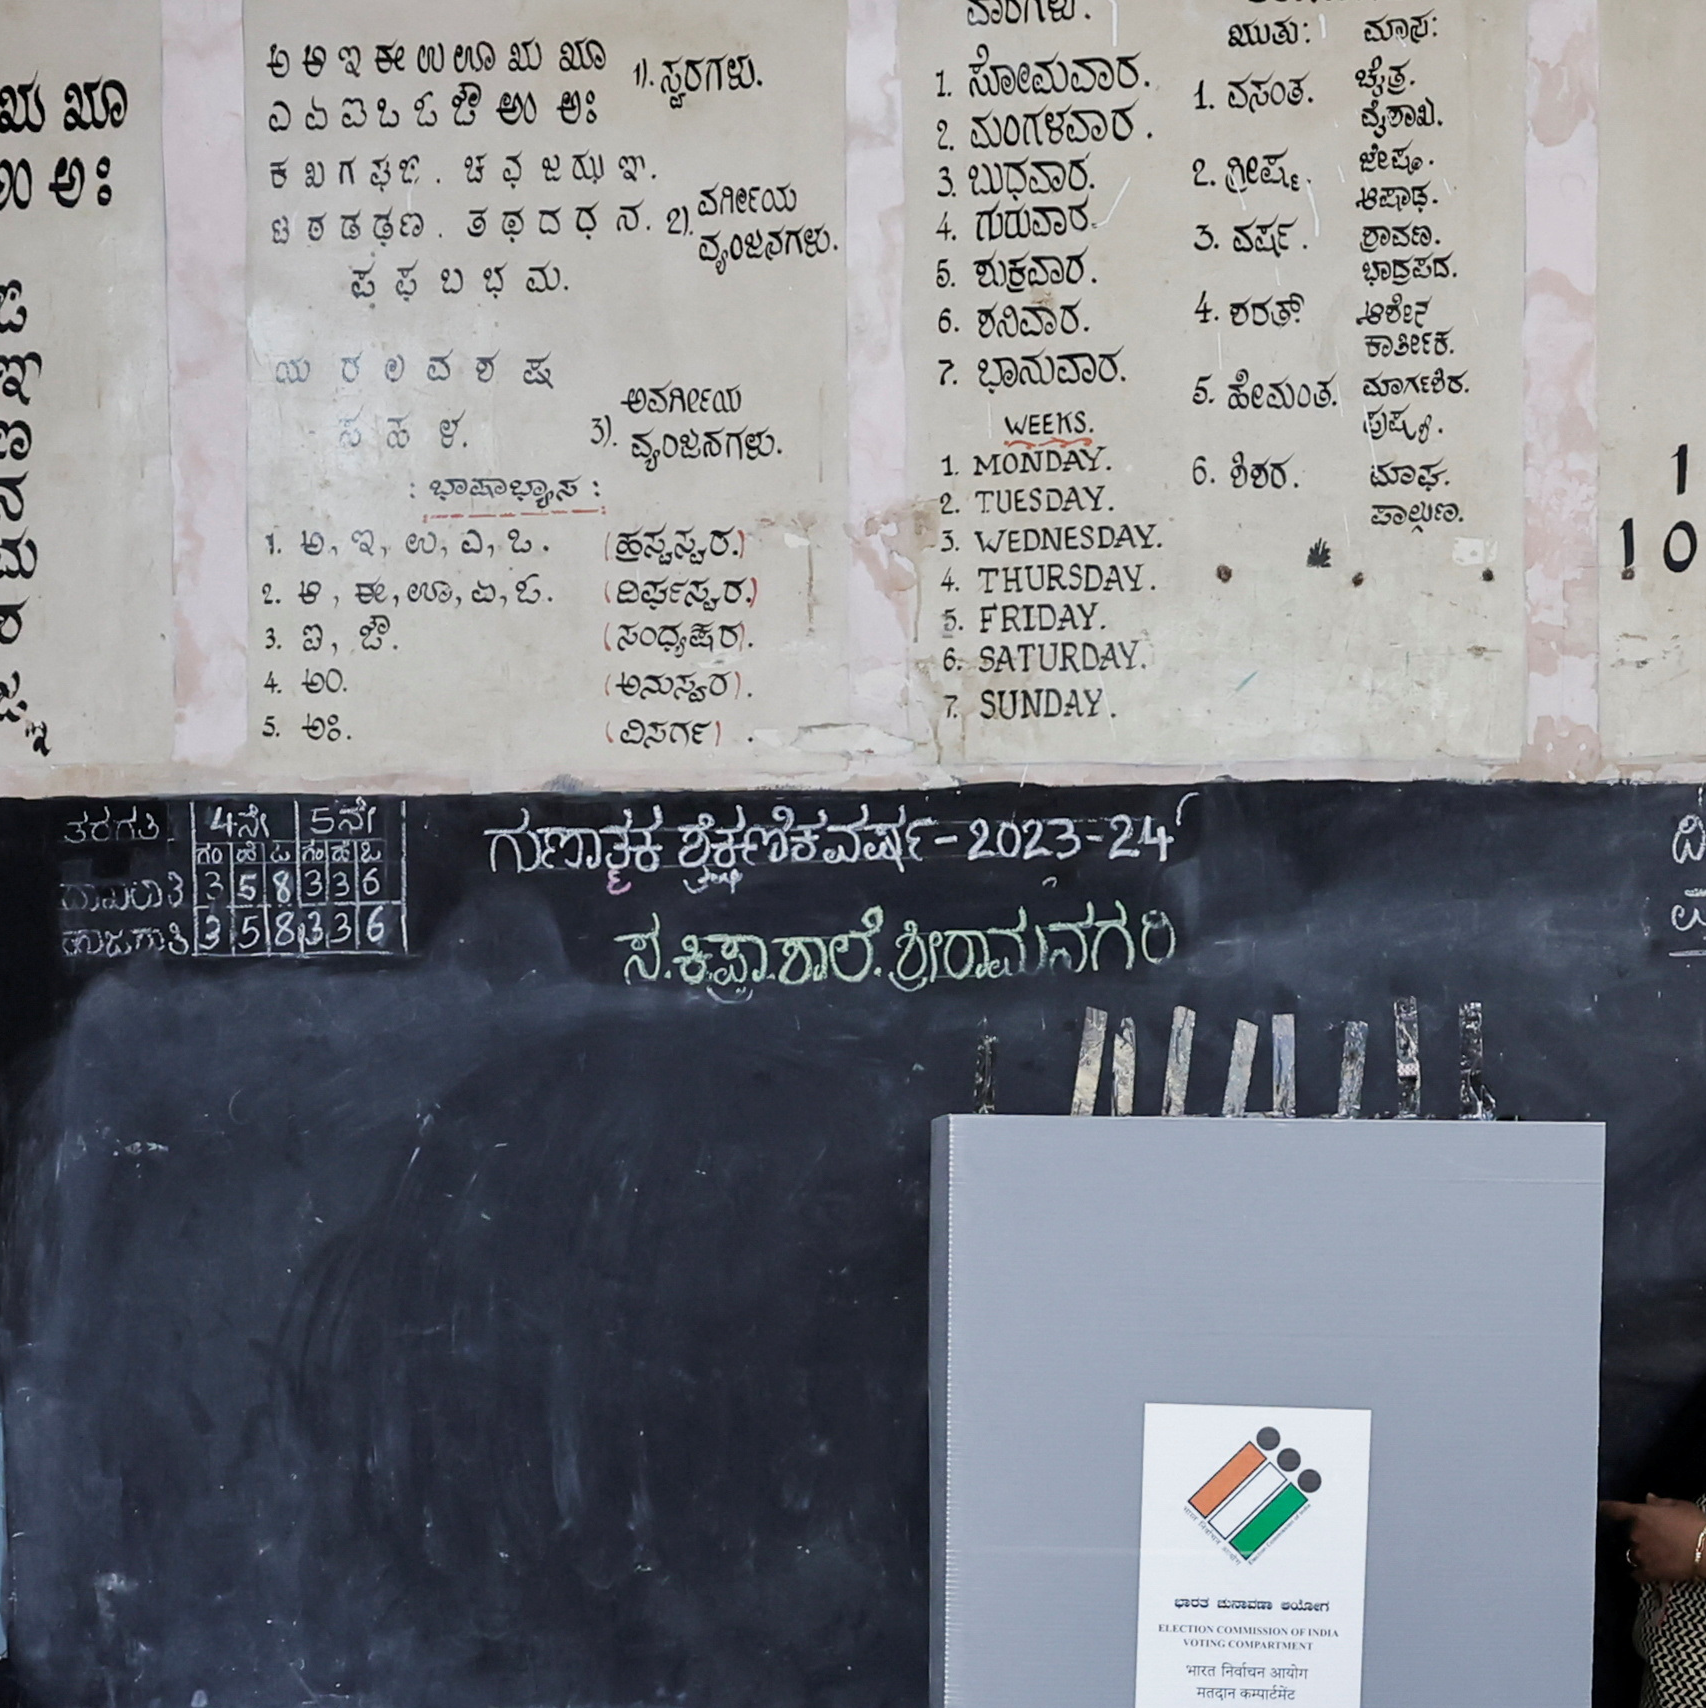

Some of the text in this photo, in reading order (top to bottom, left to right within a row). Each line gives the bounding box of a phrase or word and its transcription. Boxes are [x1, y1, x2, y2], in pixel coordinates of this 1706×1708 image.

[968, 43, 1150, 98] ಸೋಮವಾರ.
[1004, 410, 1094, 436] WEEKS.
[941, 445, 1112, 477] 1. MONDAY.
[939, 484, 1114, 515] 2. TUESDAY.
[940, 523, 1163, 554] 3. WEDNESDAY.
[940, 562, 1156, 594] 4. THURSDAY.
[941, 601, 1106, 634] 5. FRIDAY.
[943, 639, 1146, 674] 6. SATURDAY.
[943, 688, 1117, 721] 7. SUNDAY.
[204, 872, 224, 901] 3
[238, 873, 256, 901] 5
[272, 870, 293, 903] 8
[304, 869, 323, 898] 3
[333, 871, 350, 897] 3
[362, 866, 379, 895] 6
[199, 913, 224, 952] 3
[239, 915, 262, 948] 5
[274, 912, 295, 947] 8
[331, 912, 352, 943] 3
[365, 906, 385, 940] 6
[1158, 1624, 1339, 1637] ELECTION COMMISSION OF INDIA
[1184, 1639, 1313, 1650] VOTING COMPARTMENT
[1186, 1662, 1309, 1680] भारत निर्वाचन आयोग
[1197, 1686, 1236, 1700] मतदान
